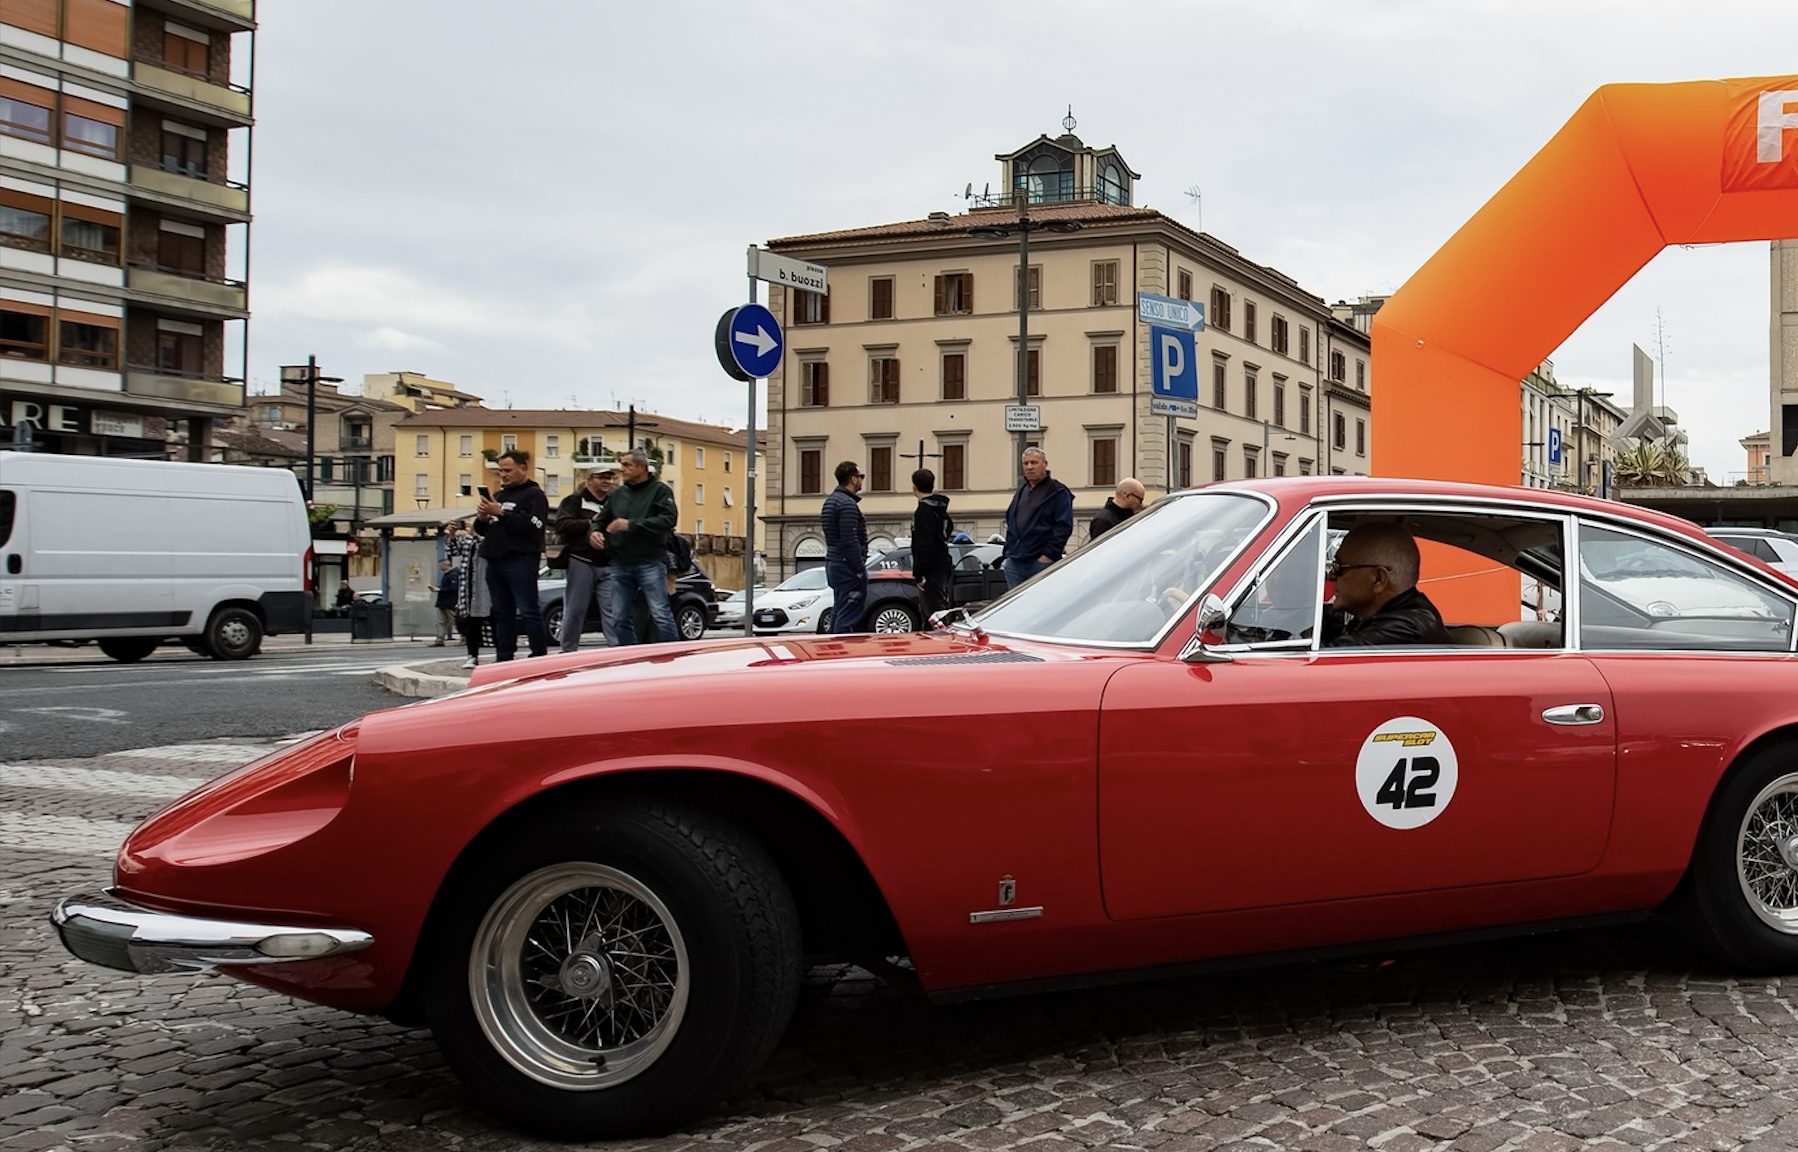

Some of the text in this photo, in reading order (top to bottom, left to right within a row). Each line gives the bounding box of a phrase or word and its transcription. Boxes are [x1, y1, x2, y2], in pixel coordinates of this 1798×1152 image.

[780, 268, 823, 289] b. buozzi
[1141, 299, 1189, 322] SENSO UNICO
[1161, 334, 1185, 391] P
[1551, 431, 1560, 460] P
[879, 560, 899, 569] 112
[1373, 731, 1437, 743] SUPERCAR
[1402, 738, 1433, 747] SLOT
[1375, 756, 1440, 810] 42
